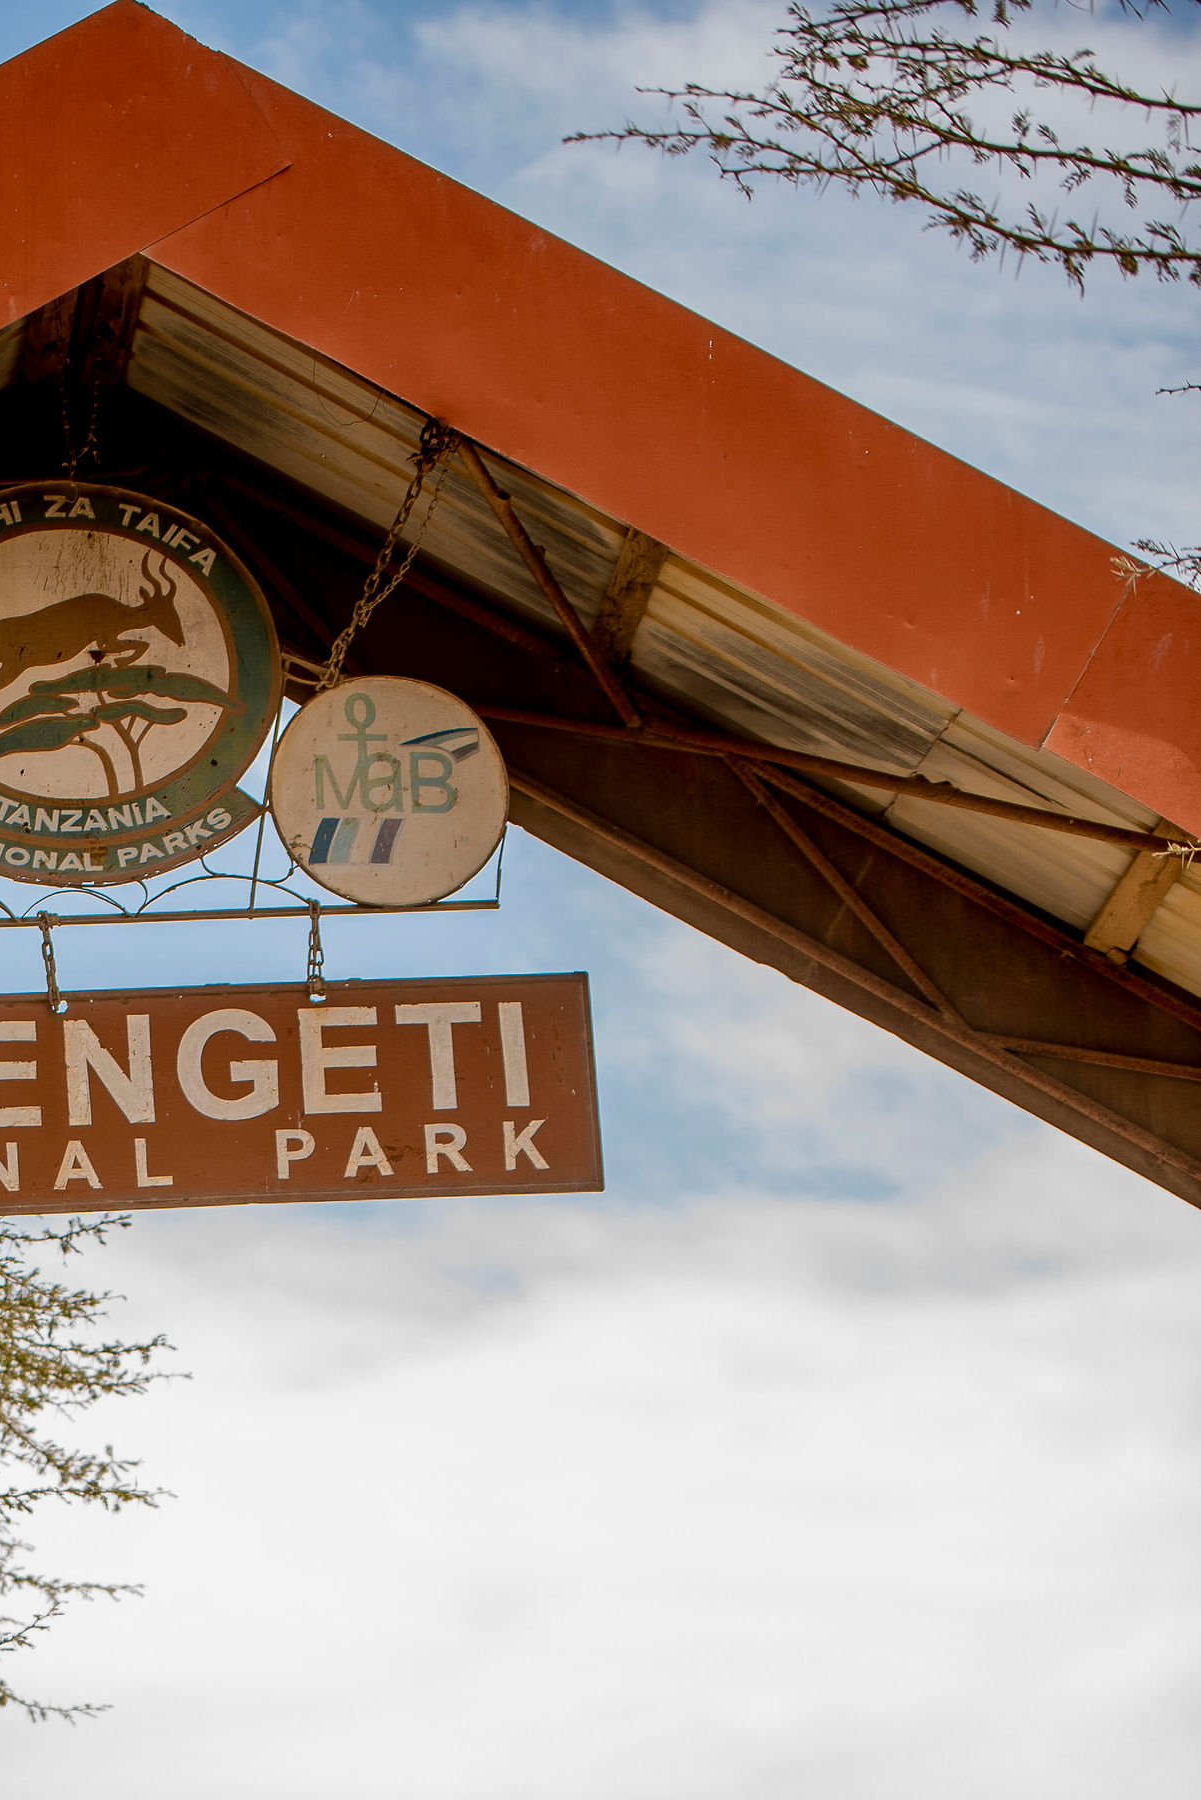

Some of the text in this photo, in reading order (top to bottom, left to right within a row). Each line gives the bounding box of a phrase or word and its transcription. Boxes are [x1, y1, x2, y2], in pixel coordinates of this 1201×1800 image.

[44, 495, 96, 518] ZA
[119, 503, 218, 577] TAIFA
[117, 806, 233, 868] PARKS
[275, 1119, 550, 1180] PARK
